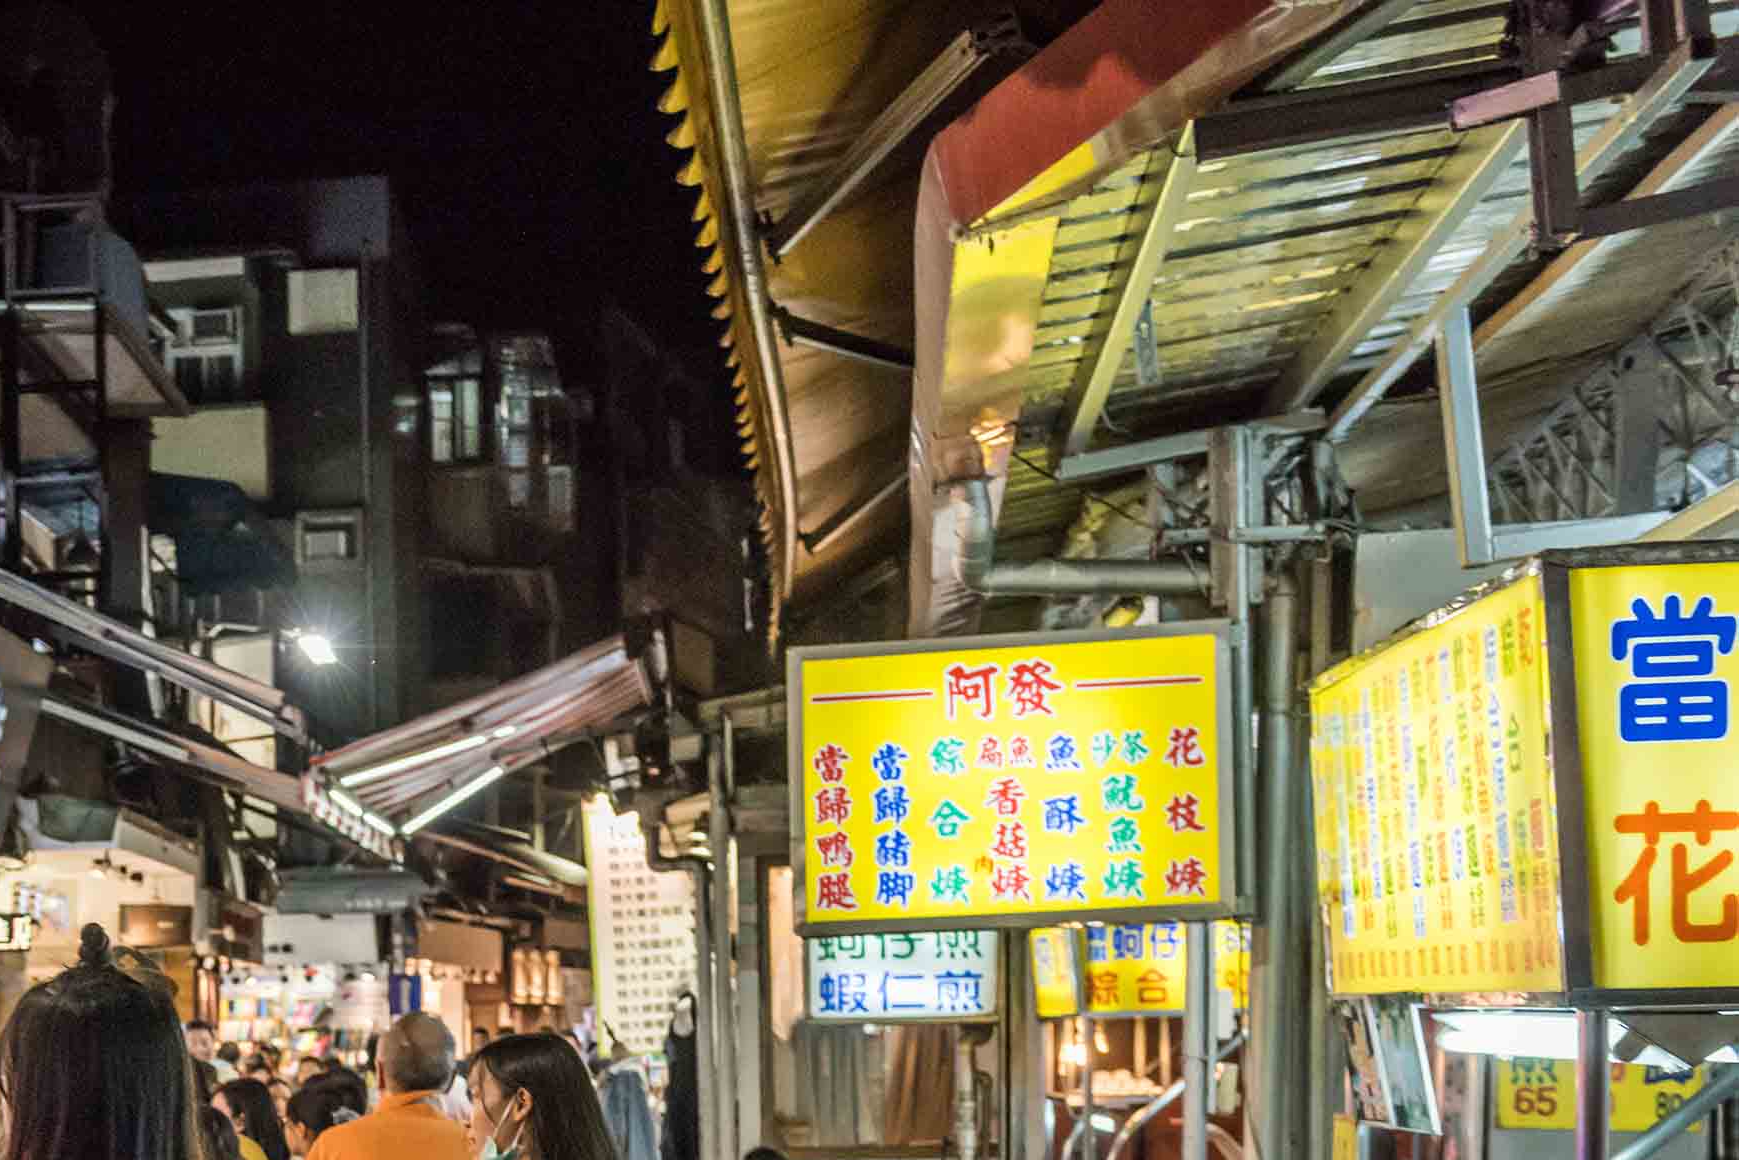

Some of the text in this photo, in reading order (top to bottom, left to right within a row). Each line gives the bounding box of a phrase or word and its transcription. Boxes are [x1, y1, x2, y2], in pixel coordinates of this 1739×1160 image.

[947, 660, 1062, 719] 阿發
[1611, 595, 1738, 743] 當
[813, 743, 859, 910] 當歸鴨腿
[1613, 799, 1739, 946] 花
[818, 969, 983, 1013] 蝦仁煎
[1513, 1087, 1559, 1117] 65
